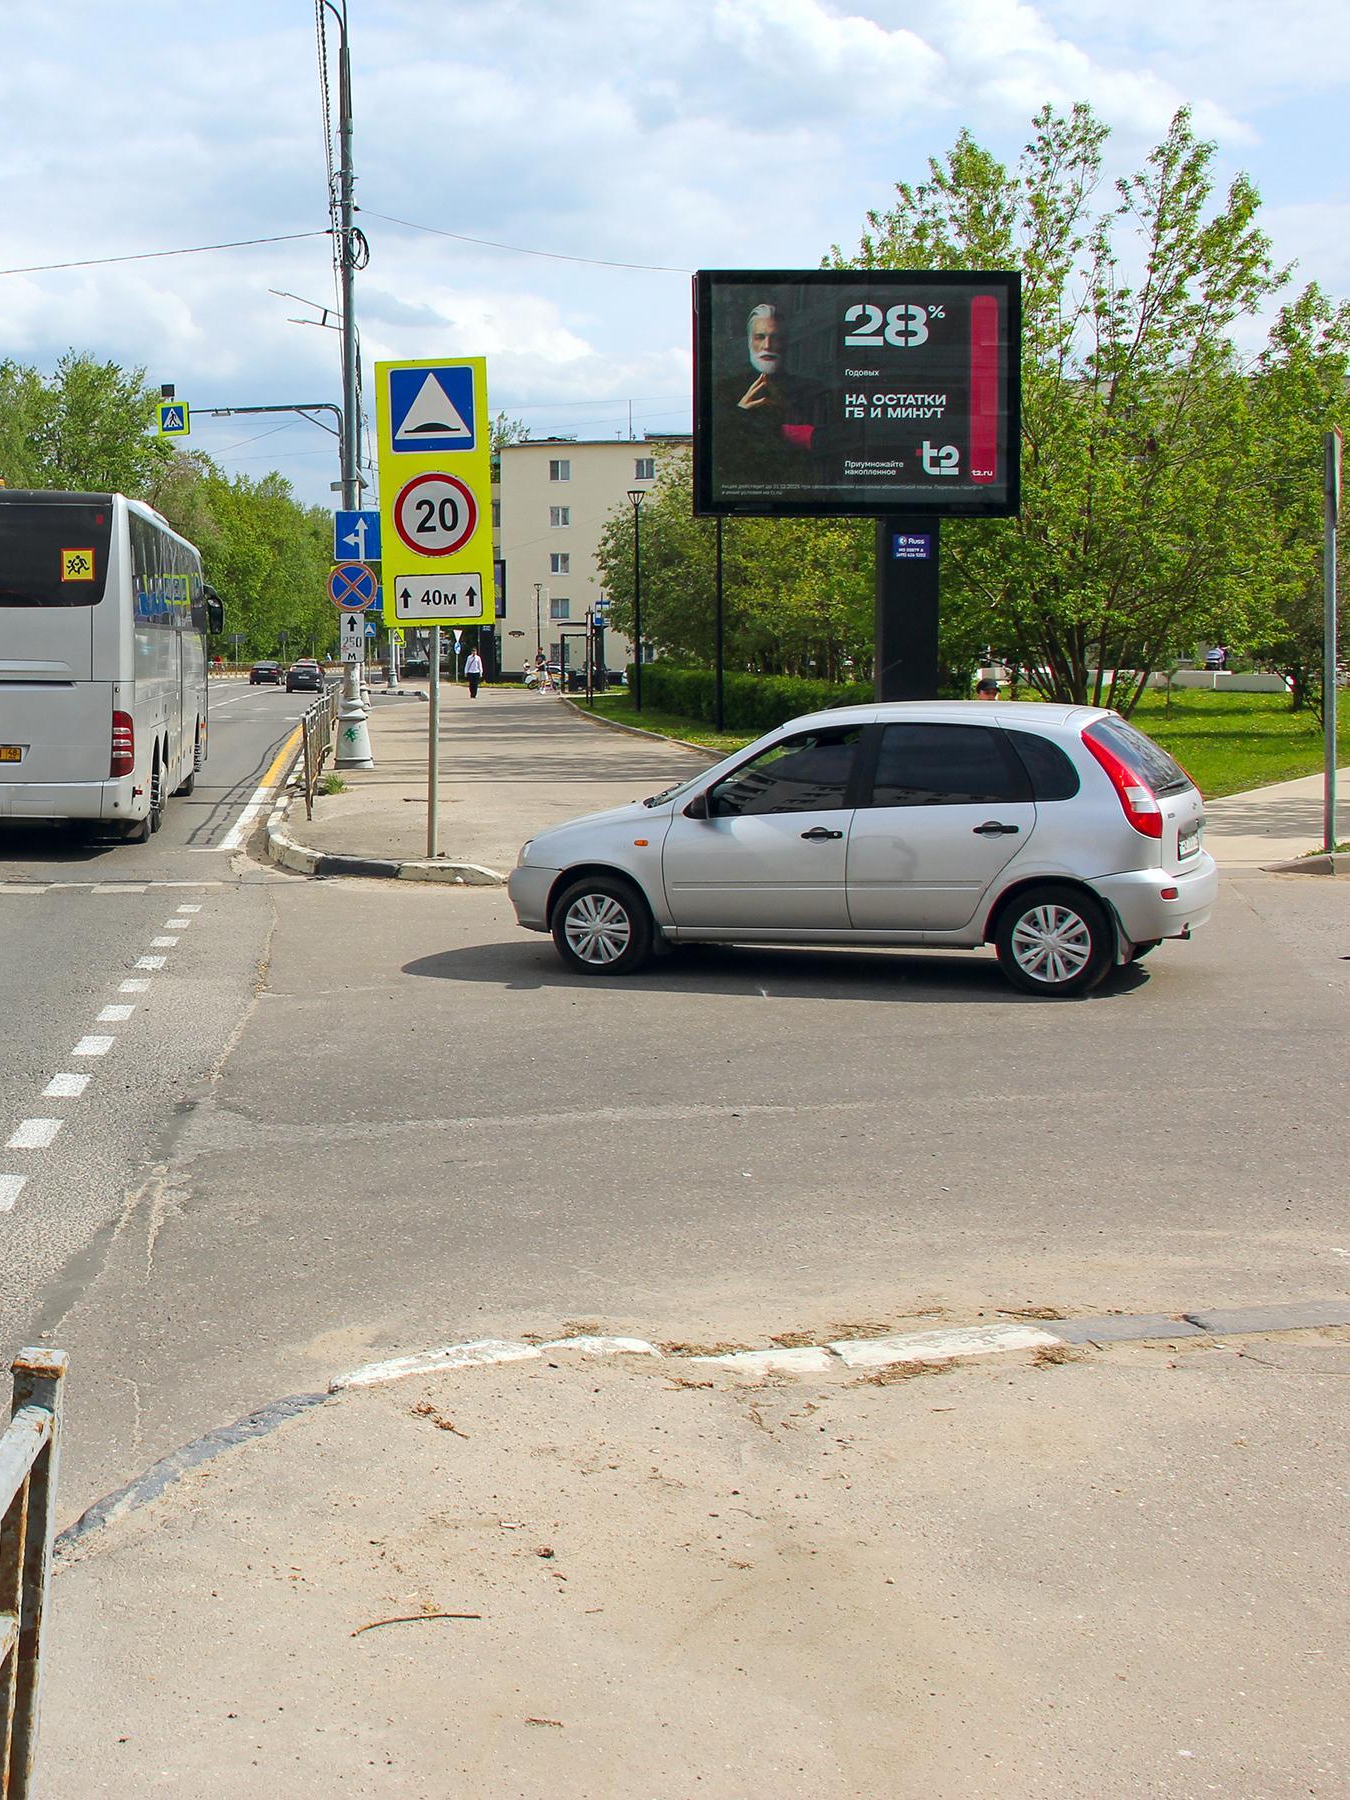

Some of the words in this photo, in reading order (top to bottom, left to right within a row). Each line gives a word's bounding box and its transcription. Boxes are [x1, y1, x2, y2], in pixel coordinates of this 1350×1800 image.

[845, 368, 880, 378] Годовых
[845, 394, 868, 406] НА
[872, 394, 947, 406] ОСТАТКИ
[845, 407, 865, 419] ГБ
[870, 407, 882, 419] И
[887, 407, 945, 419] МИНУТ
[916, 440, 960, 476] t2
[844, 460, 905, 469] Приумножайте
[844, 469, 897, 477] накопленное
[971, 468, 994, 478] t2.ru
[415, 498, 459, 534] 20
[420, 589, 457, 606] 40м
